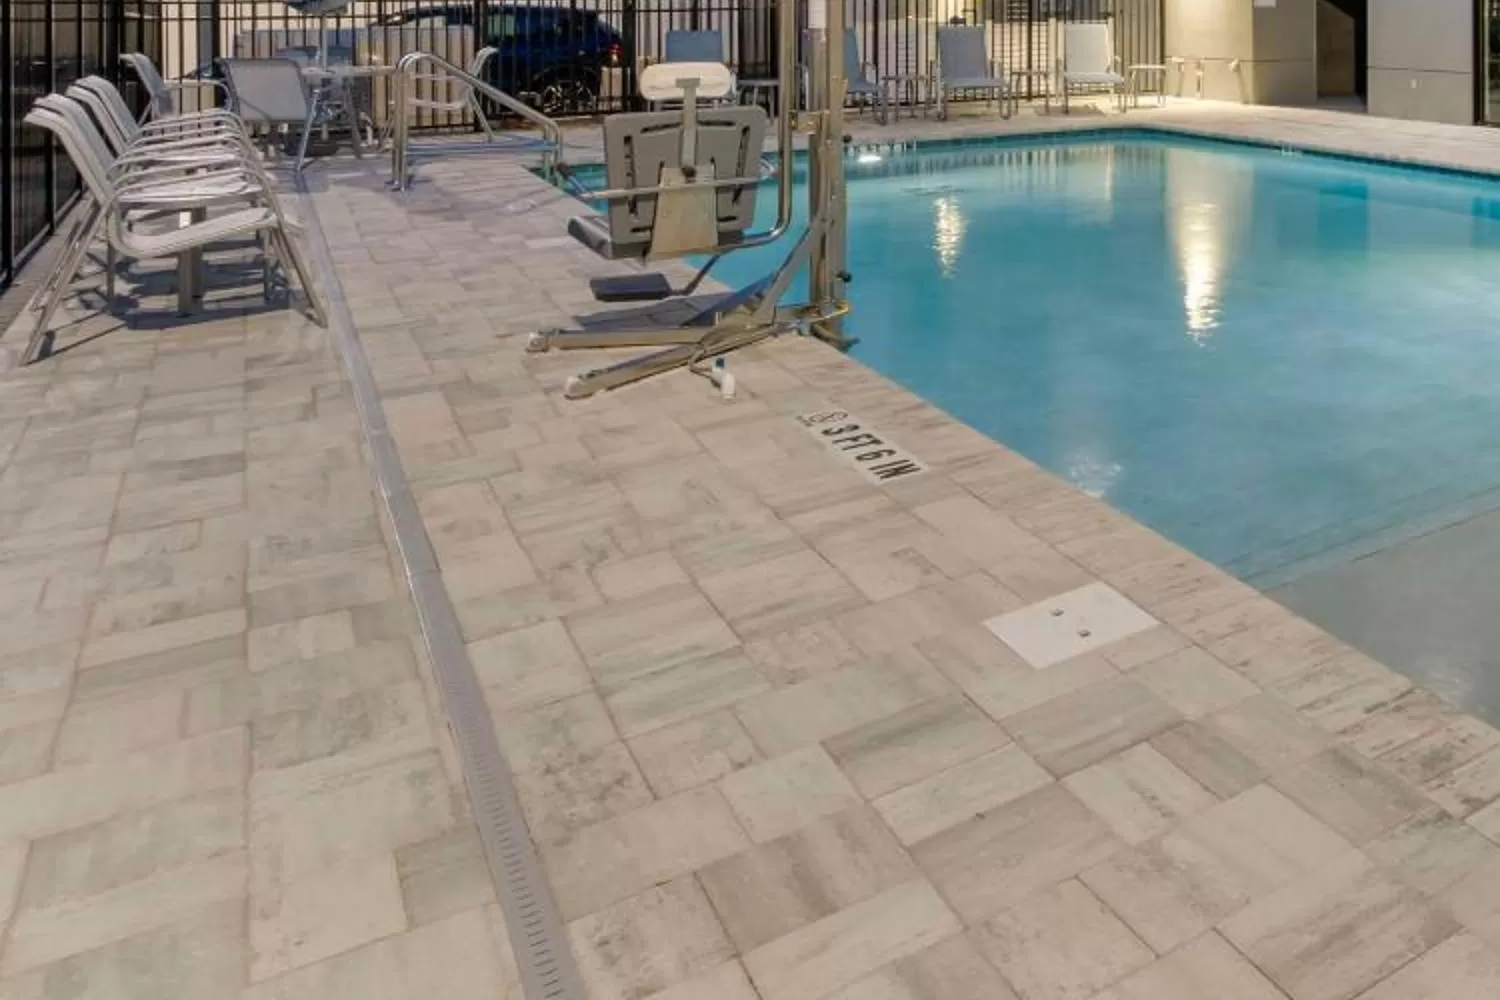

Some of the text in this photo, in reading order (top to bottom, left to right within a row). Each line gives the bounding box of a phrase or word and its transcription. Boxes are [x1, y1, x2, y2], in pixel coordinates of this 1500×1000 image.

[831, 432, 885, 452] FT
[854, 448, 897, 462] 6
[867, 458, 923, 481] IN
